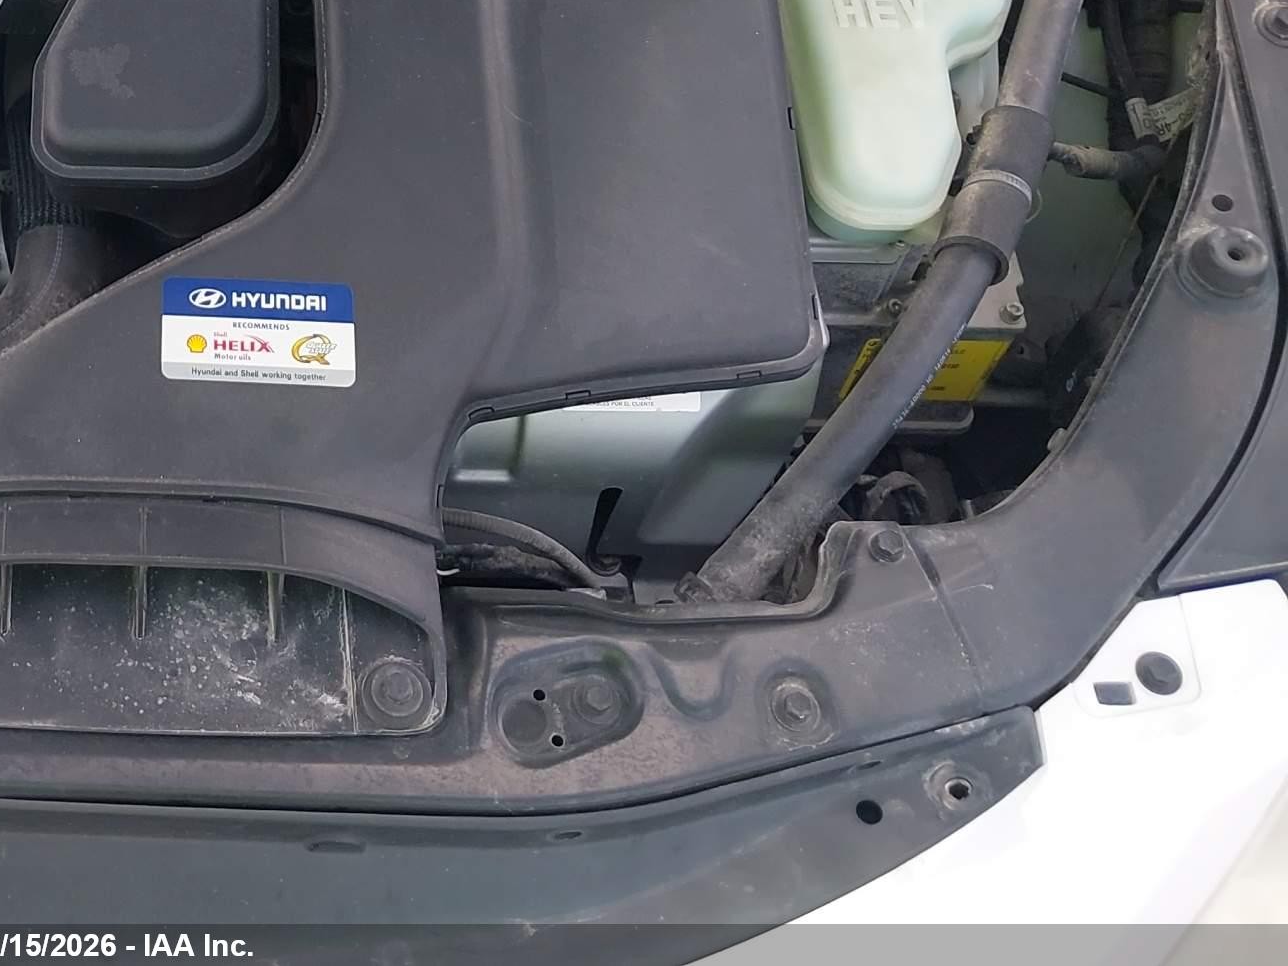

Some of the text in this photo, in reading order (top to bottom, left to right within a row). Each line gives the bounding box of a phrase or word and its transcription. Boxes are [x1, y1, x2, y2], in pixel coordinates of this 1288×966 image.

[231, 291, 327, 312] HYUNDAI
[232, 321, 291, 331] RECOMMENDS
[213, 337, 275, 353] HELIX
[214, 352, 237, 361] Motor
[191, 367, 327, 382] Hyundai and Shell working together
